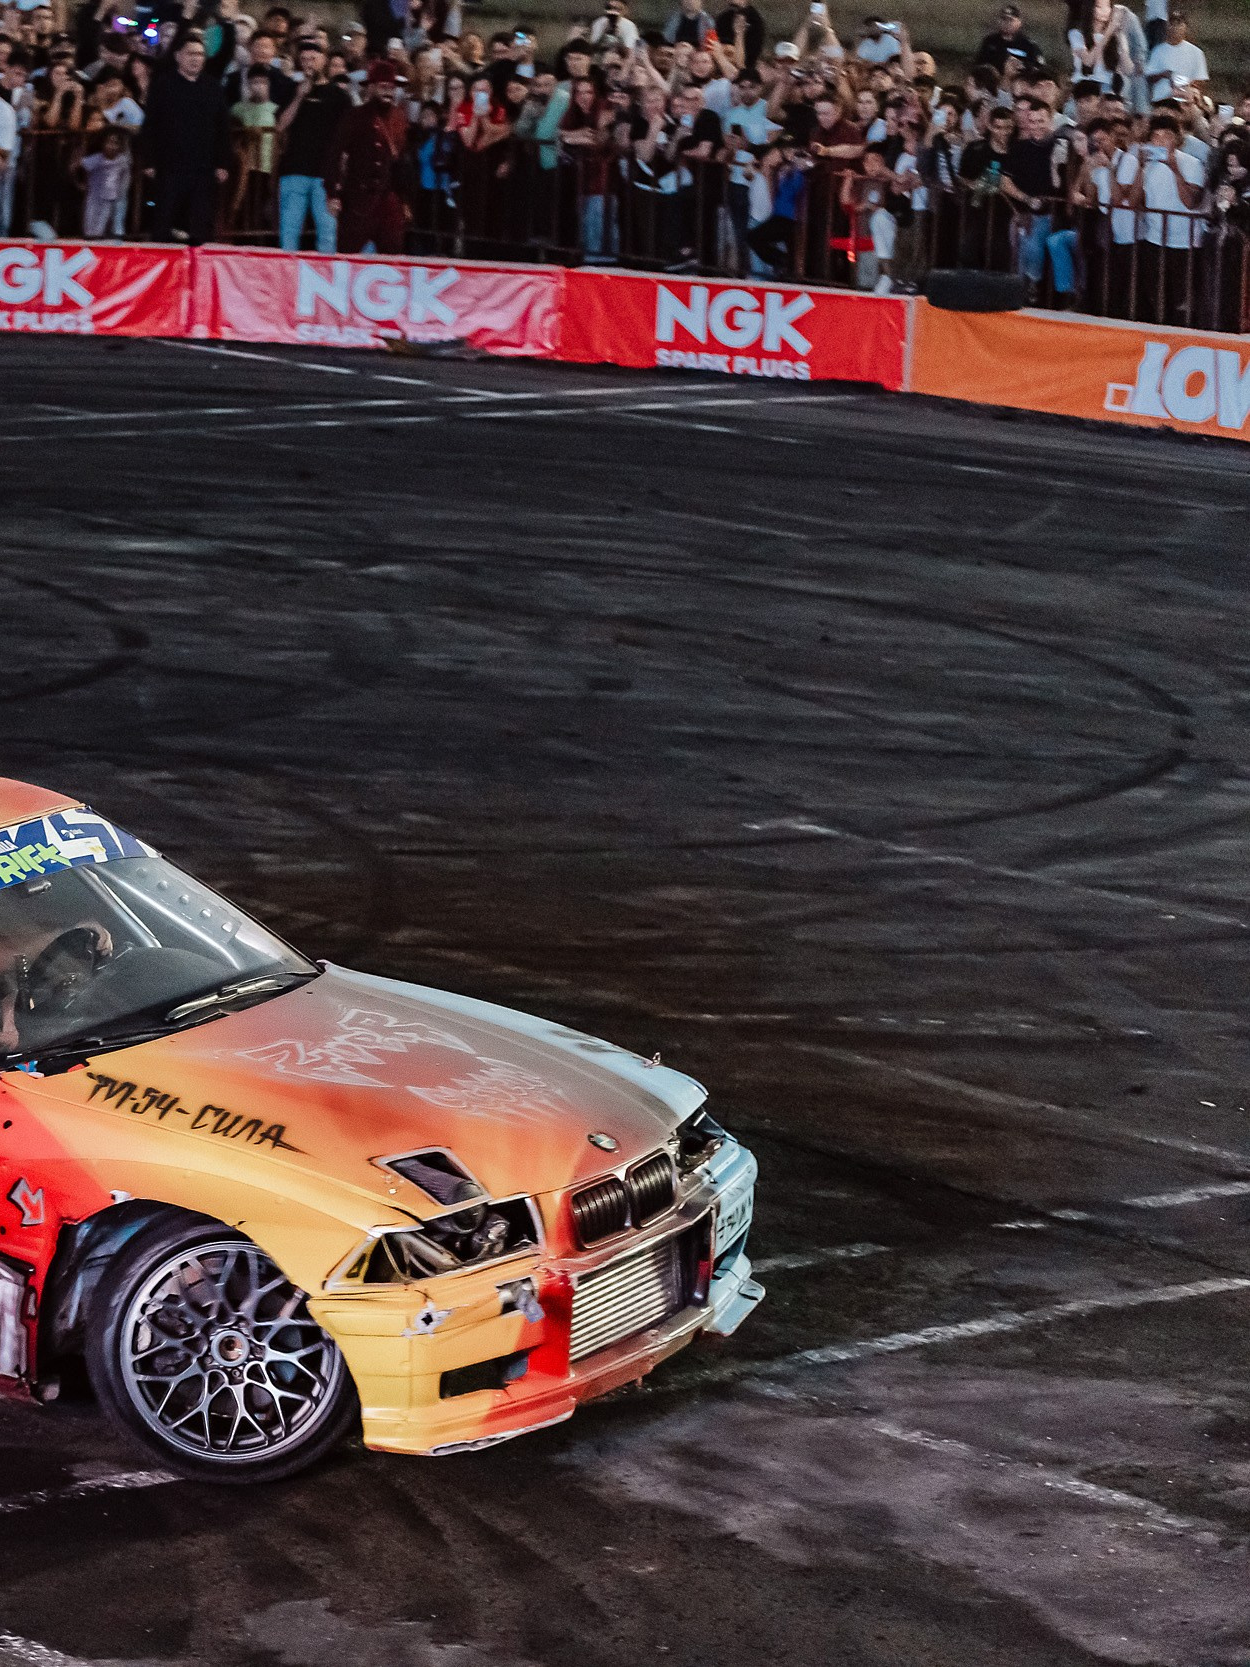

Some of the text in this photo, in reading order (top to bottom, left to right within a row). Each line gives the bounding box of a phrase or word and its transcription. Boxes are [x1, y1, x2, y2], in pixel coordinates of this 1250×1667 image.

[297, 259, 460, 325] NGK
[13, 311, 95, 333] PLUGS
[655, 284, 815, 356] NGK
[655, 347, 811, 381] SPARK PLUGS
